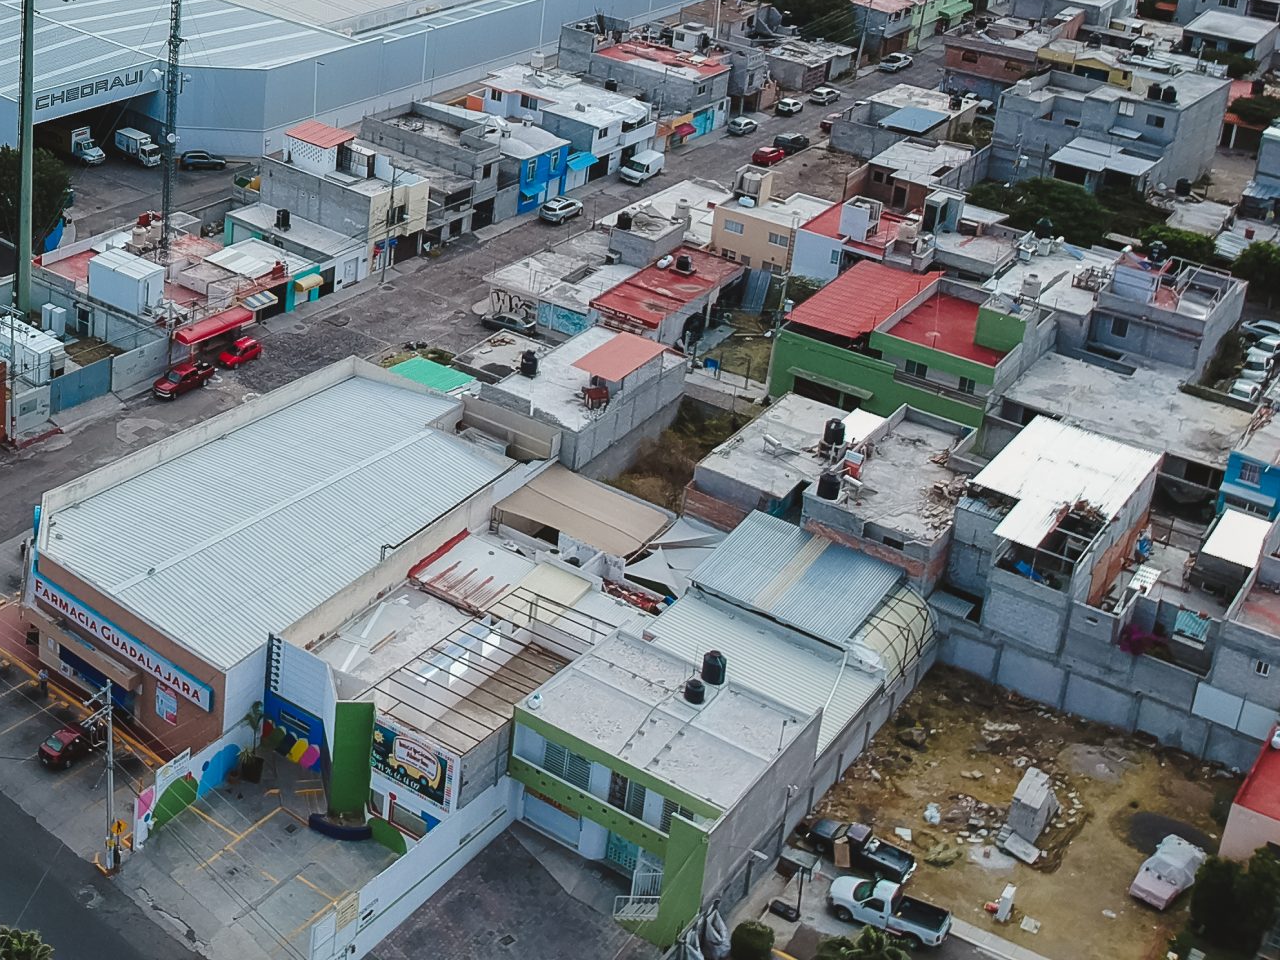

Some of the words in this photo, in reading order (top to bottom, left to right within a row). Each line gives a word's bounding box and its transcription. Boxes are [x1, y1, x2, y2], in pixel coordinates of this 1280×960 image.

[35, 69, 144, 111] CHEDRAUI
[35, 579, 98, 633] FARMACIA
[100, 625, 202, 703] GUADALAJARA
